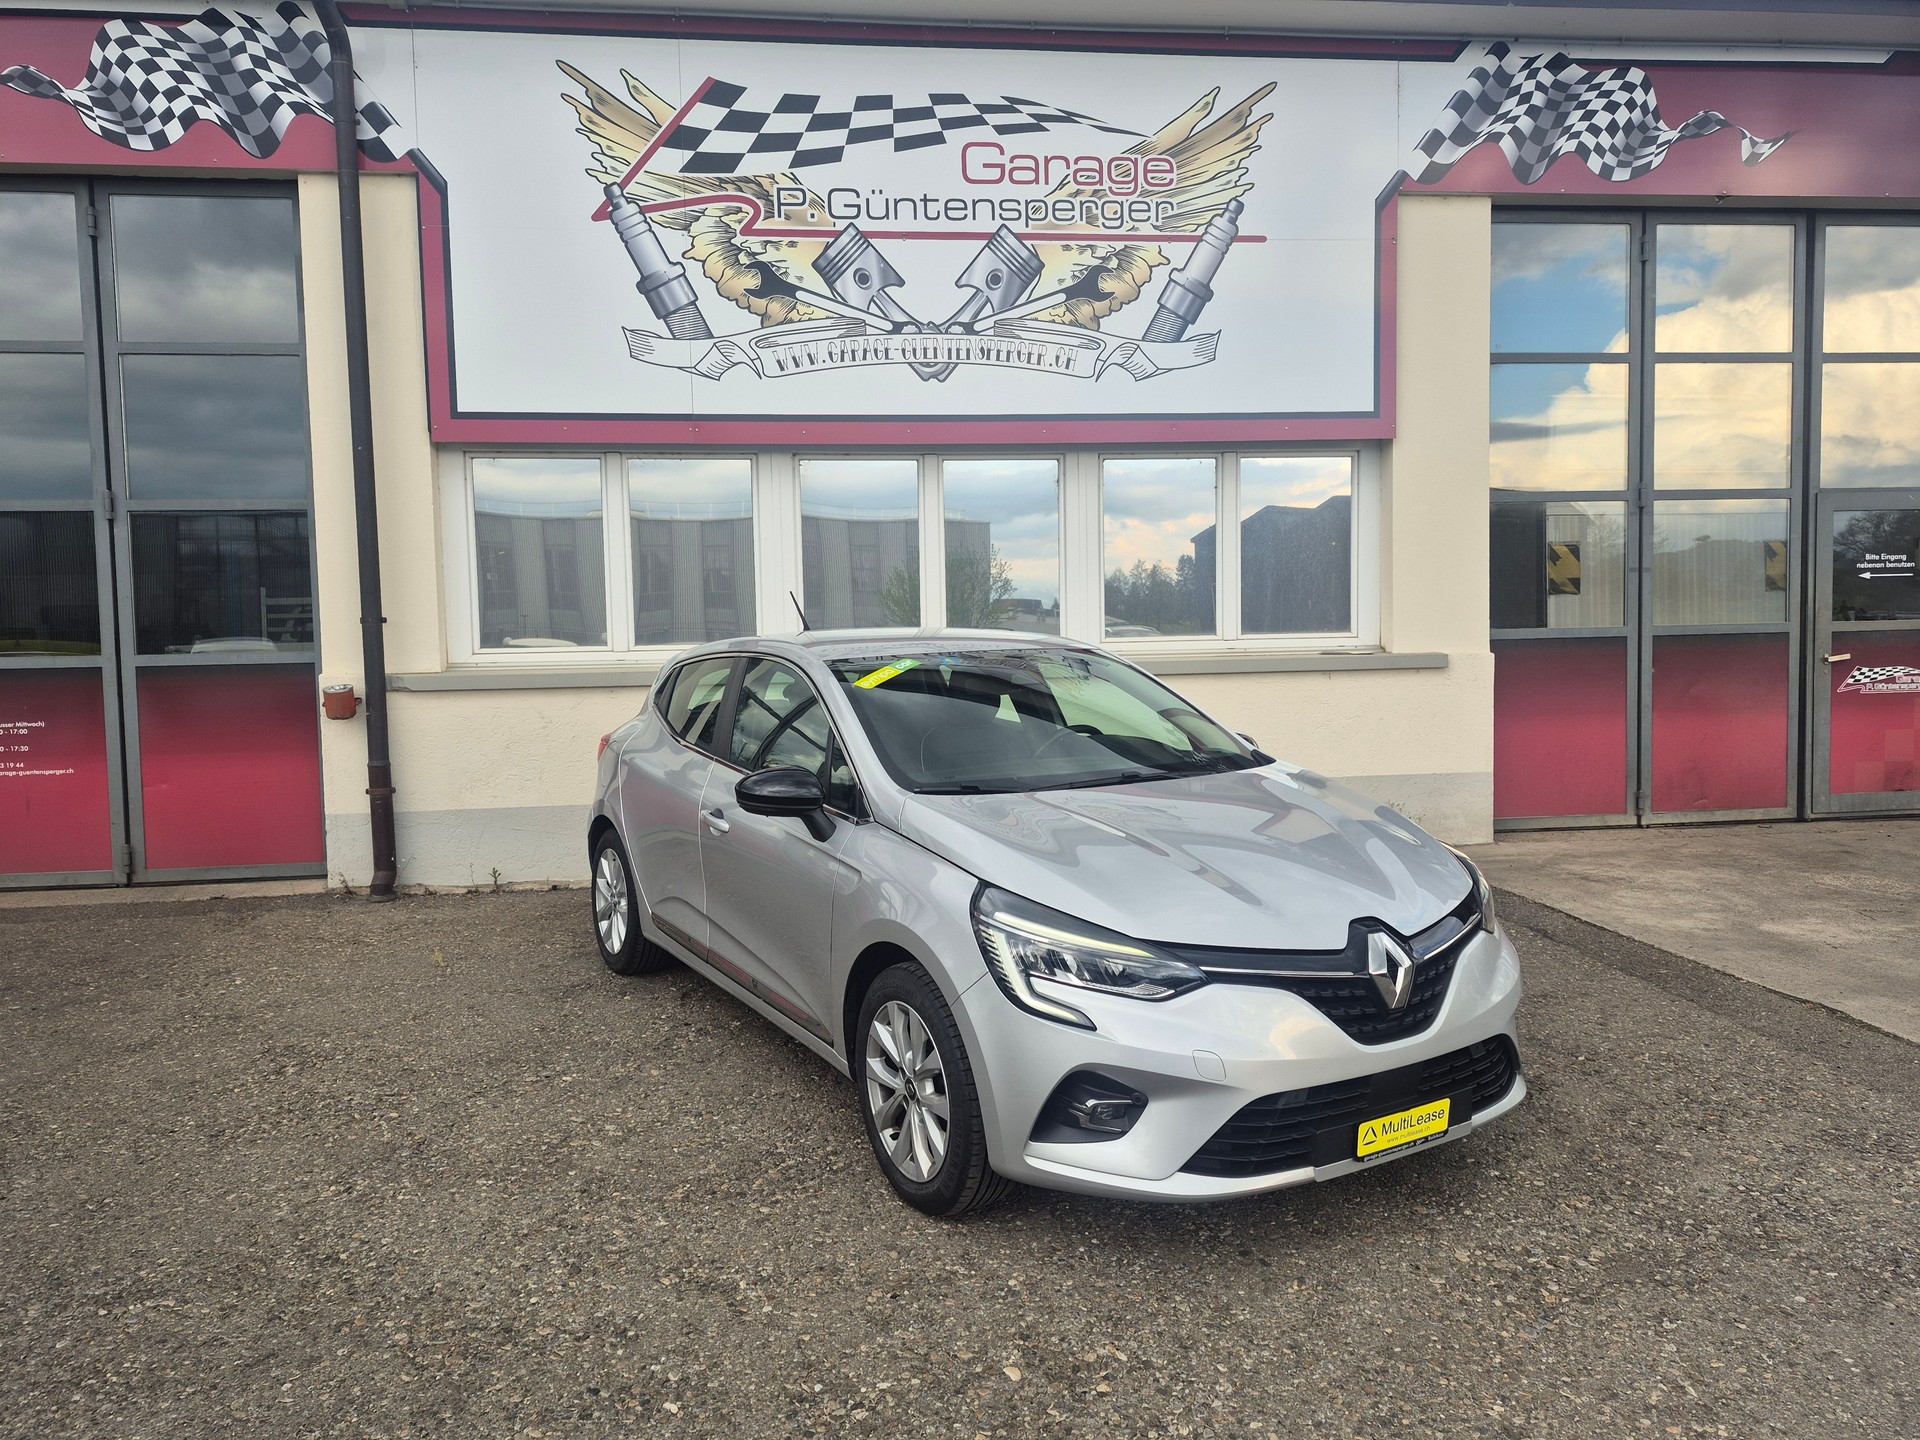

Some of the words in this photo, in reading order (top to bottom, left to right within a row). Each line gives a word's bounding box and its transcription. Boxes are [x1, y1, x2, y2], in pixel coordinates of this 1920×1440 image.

[961, 141, 1175, 197] Garage
[828, 187, 1176, 229] Güntensperger
[771, 337, 1079, 372] WWW.GARAGE-GUENTENSPERGER.CH
[1881, 553, 1907, 561] Eingang
[895, 660, 913, 669] car
[0, 768, 74, 776] arage-guentensperger.ch
[1381, 1109, 1446, 1137] MultiLease
